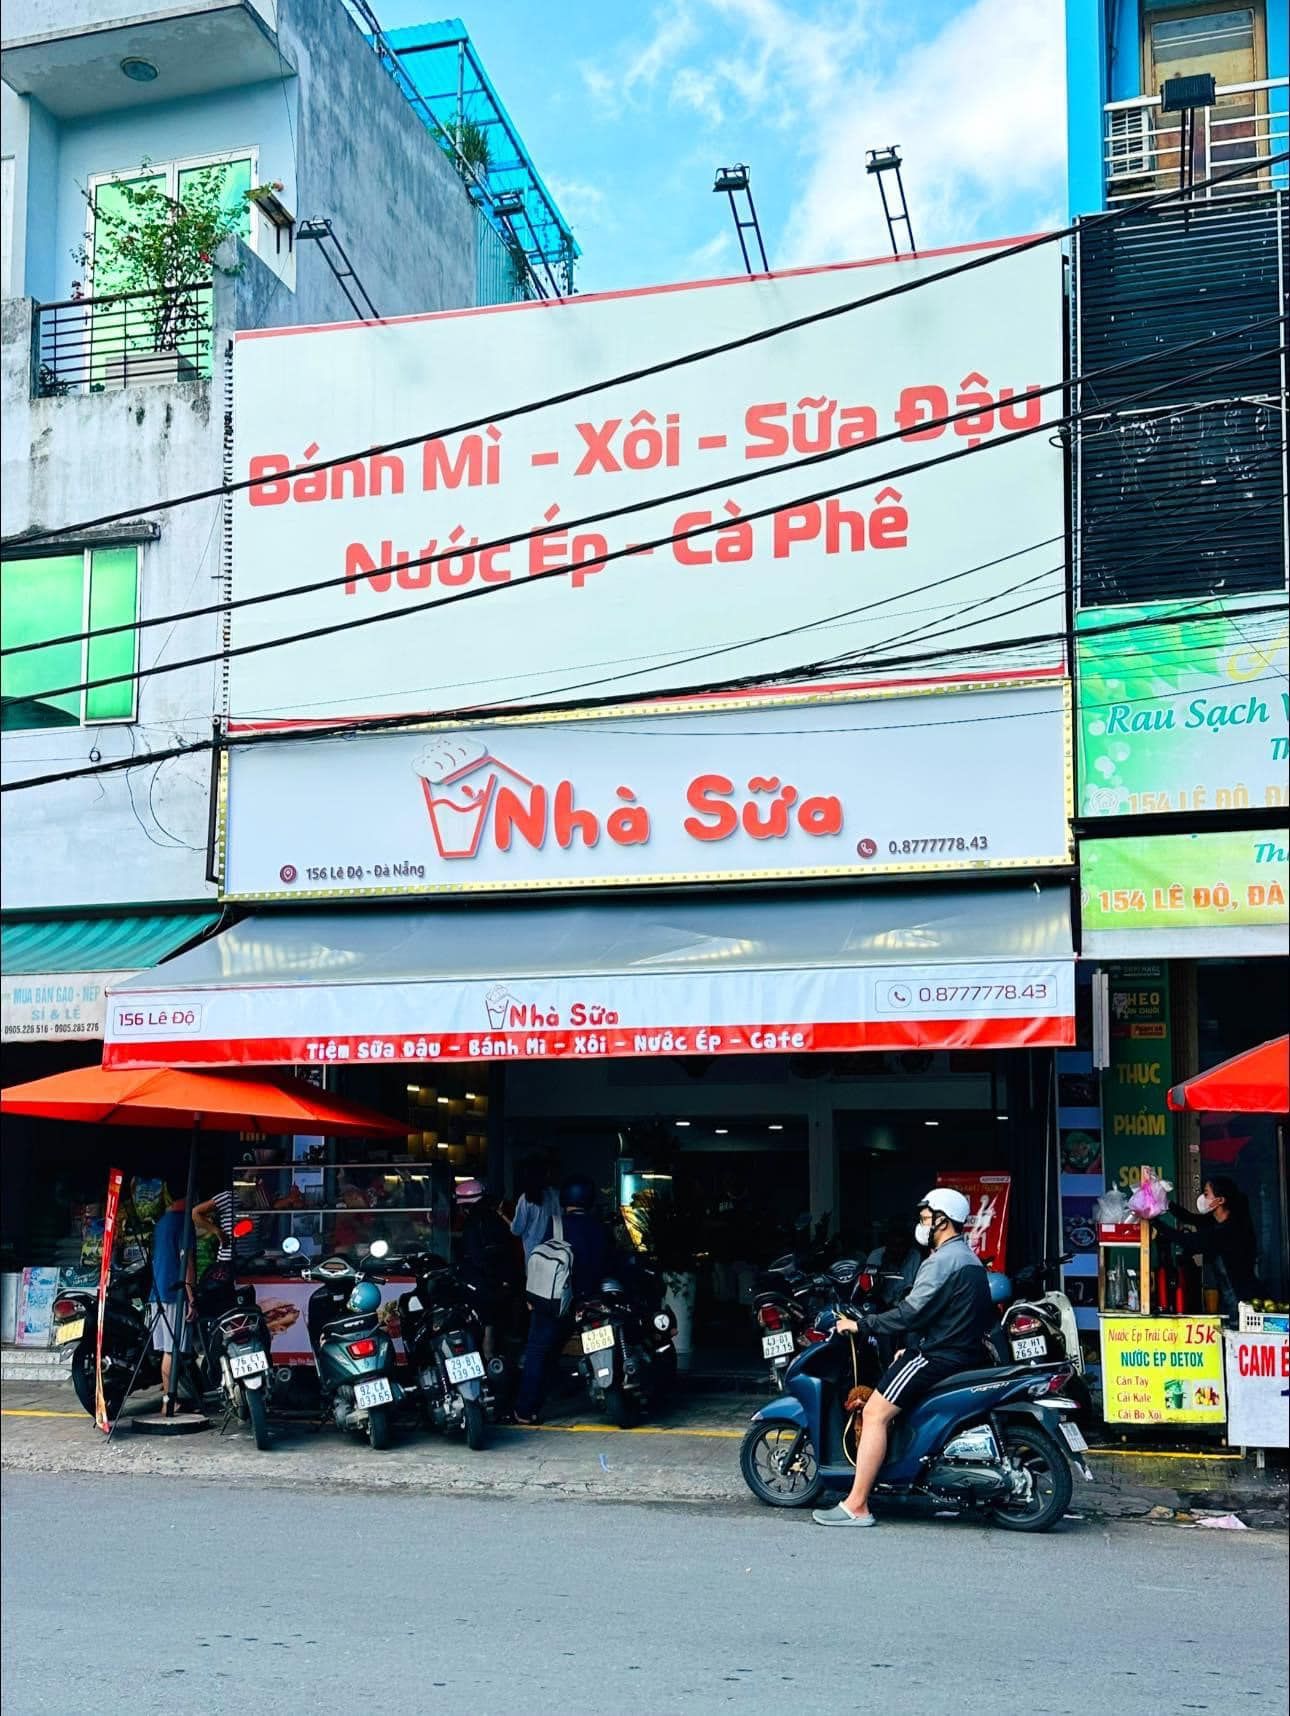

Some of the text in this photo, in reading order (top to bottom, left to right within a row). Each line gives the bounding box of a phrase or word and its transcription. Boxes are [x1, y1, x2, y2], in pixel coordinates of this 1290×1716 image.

[249, 442, 404, 507] Bánh
[422, 423, 502, 491] Mì
[574, 409, 680, 476] Xôi
[744, 394, 878, 460] Sữa
[895, 371, 1042, 449] Đậu
[344, 524, 511, 594] Nước
[528, 503, 608, 588] Ép
[672, 498, 753, 566] Cà
[773, 486, 909, 559] Phê
[1107, 704, 1175, 735] Rau
[1184, 696, 1270, 734] Sạch
[494, 774, 843, 851] Nhà Sữa
[888, 836, 989, 855] 0.8777778.43
[306, 867, 327, 880] 156
[330, 866, 345, 880] Lê
[347, 864, 363, 881] Độ
[374, 864, 390, 877] Đà
[1098, 889, 1145, 912] 154
[1154, 884, 1186, 911] LÊ
[1248, 880, 1286, 907] ĐÀ
[919, 984, 1047, 1002] 0.8777778.43
[119, 1010, 195, 1026] 156 Lê Độ
[509, 1003, 619, 1027] Nhà Sữa
[306, 1040, 349, 1063] Tiệm
[402, 1037, 441, 1061] Đậu
[468, 1036, 519, 1056] Bánh
[574, 1034, 607, 1054] Xôi
[634, 1031, 688, 1052] Nước
[695, 1029, 722, 1052] Ép
[750, 1031, 804, 1049] Cafe
[1184, 1324, 1217, 1345] 15k
[1120, 1348, 1204, 1367] NƯỚC ÉP DETOX
[1239, 1344, 1276, 1377] CAM
